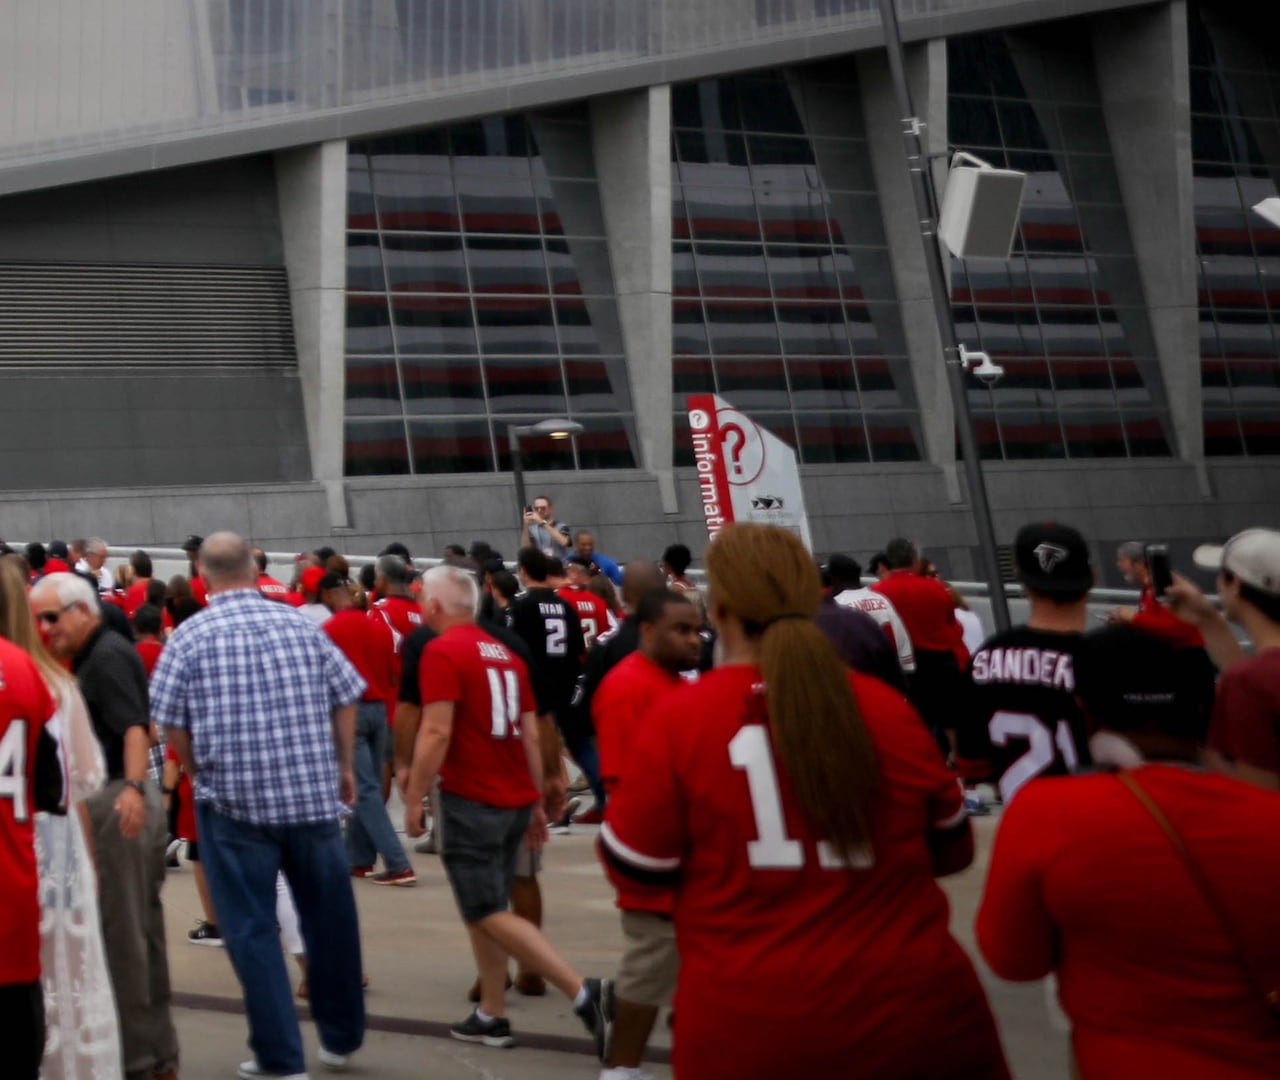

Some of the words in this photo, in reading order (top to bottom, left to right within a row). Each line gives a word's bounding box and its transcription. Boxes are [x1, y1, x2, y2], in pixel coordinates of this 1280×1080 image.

[538, 602, 564, 615] RYAN
[544, 617, 567, 655] 2
[728, 724, 876, 869] 1
